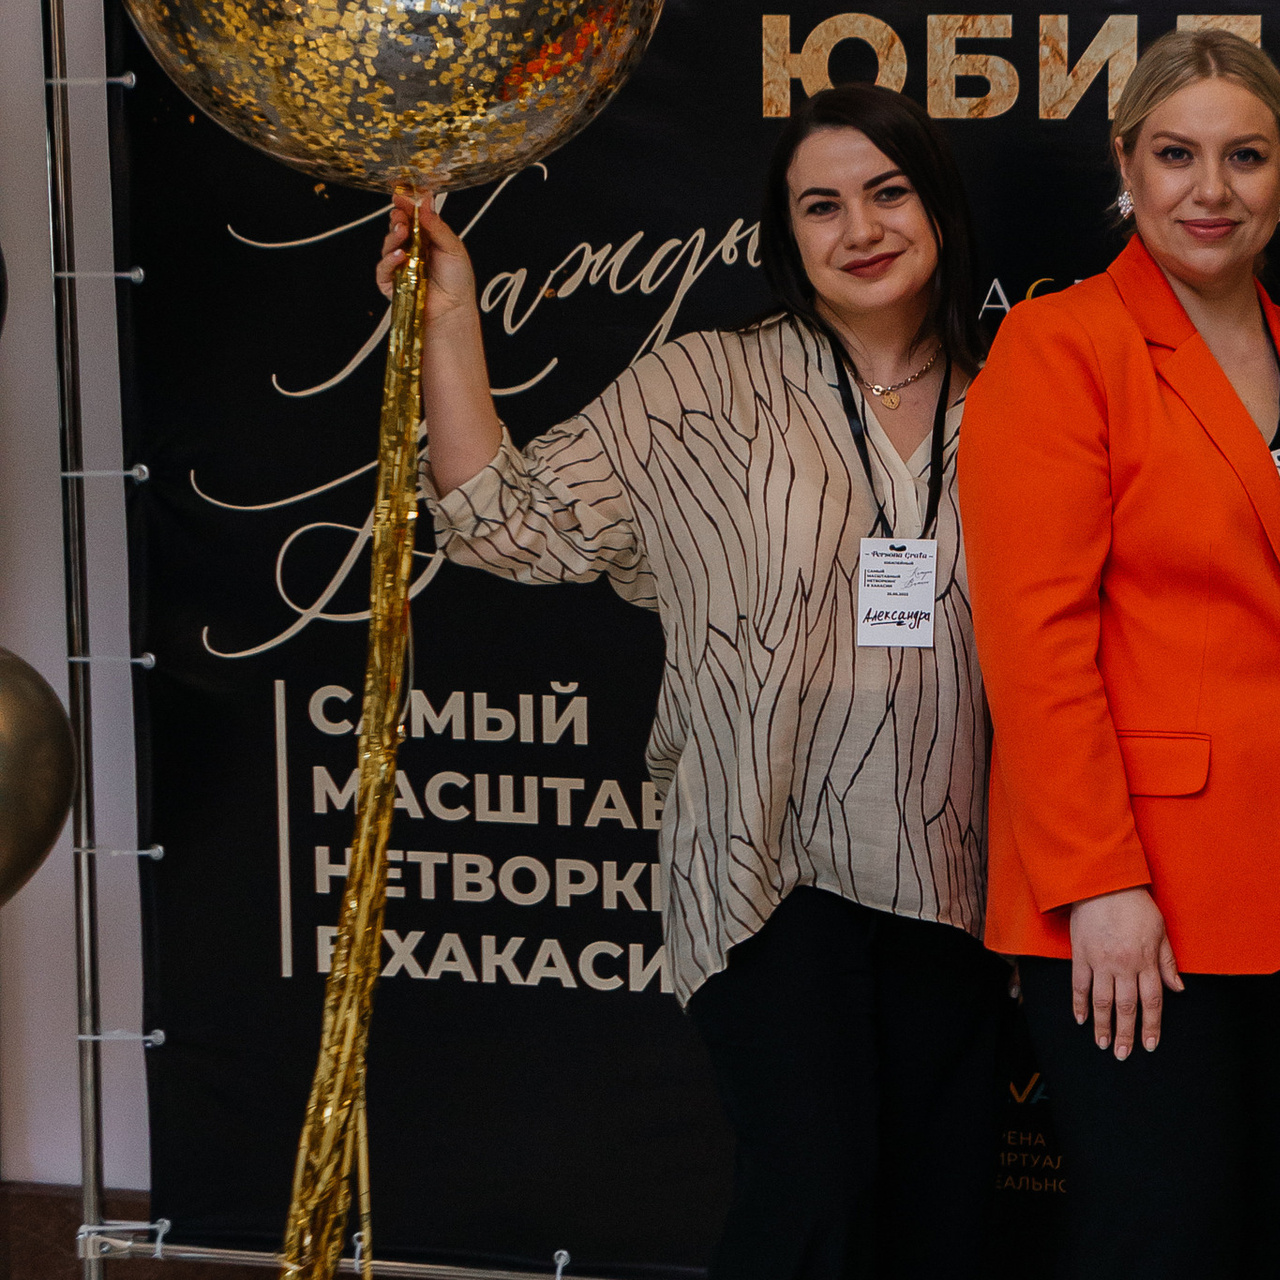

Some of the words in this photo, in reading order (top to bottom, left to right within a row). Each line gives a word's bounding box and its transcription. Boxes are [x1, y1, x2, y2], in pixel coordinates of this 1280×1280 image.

[862, 607, 931, 630] Александра
[308, 681, 589, 746] СМЫЙ
[1002, 1130, 1047, 1147] ЕНА
